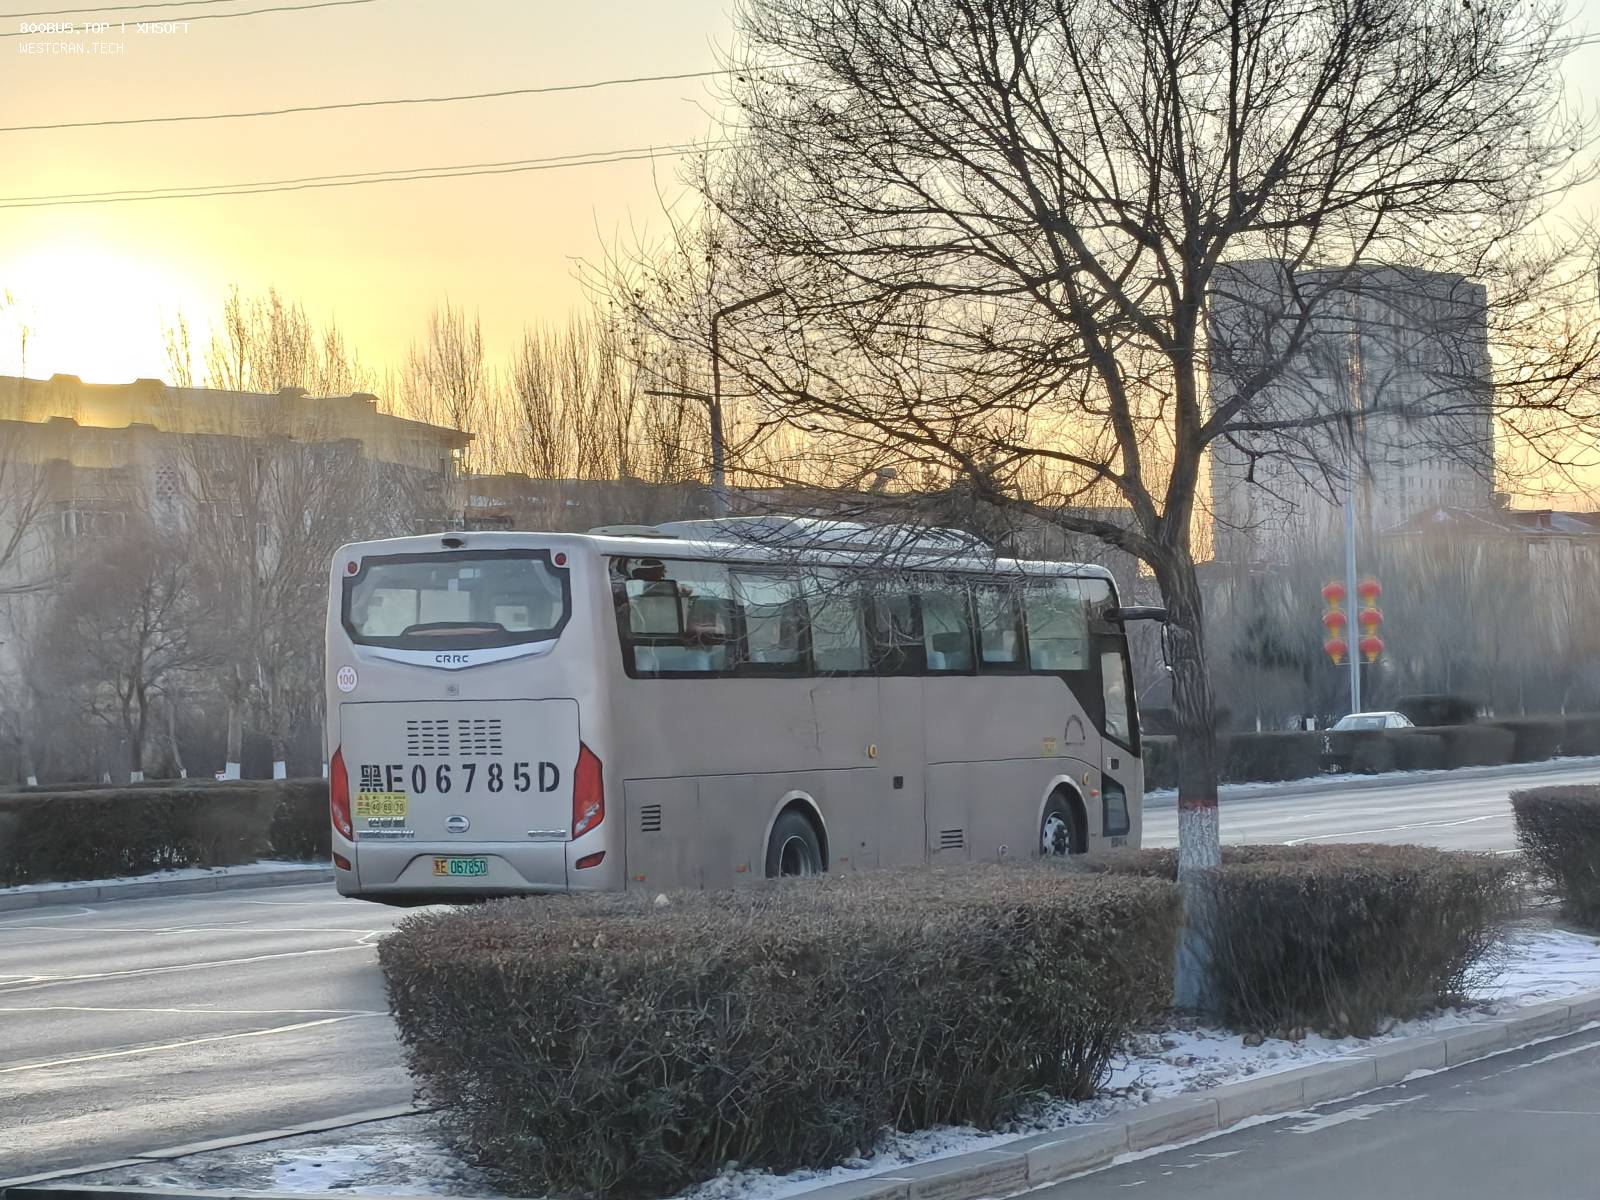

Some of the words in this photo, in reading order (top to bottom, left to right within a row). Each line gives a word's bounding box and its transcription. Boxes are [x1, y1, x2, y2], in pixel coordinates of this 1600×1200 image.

[435, 654, 469, 664] CRRC
[339, 674, 355, 685] 100
[360, 762, 560, 794] 黑E06785D
